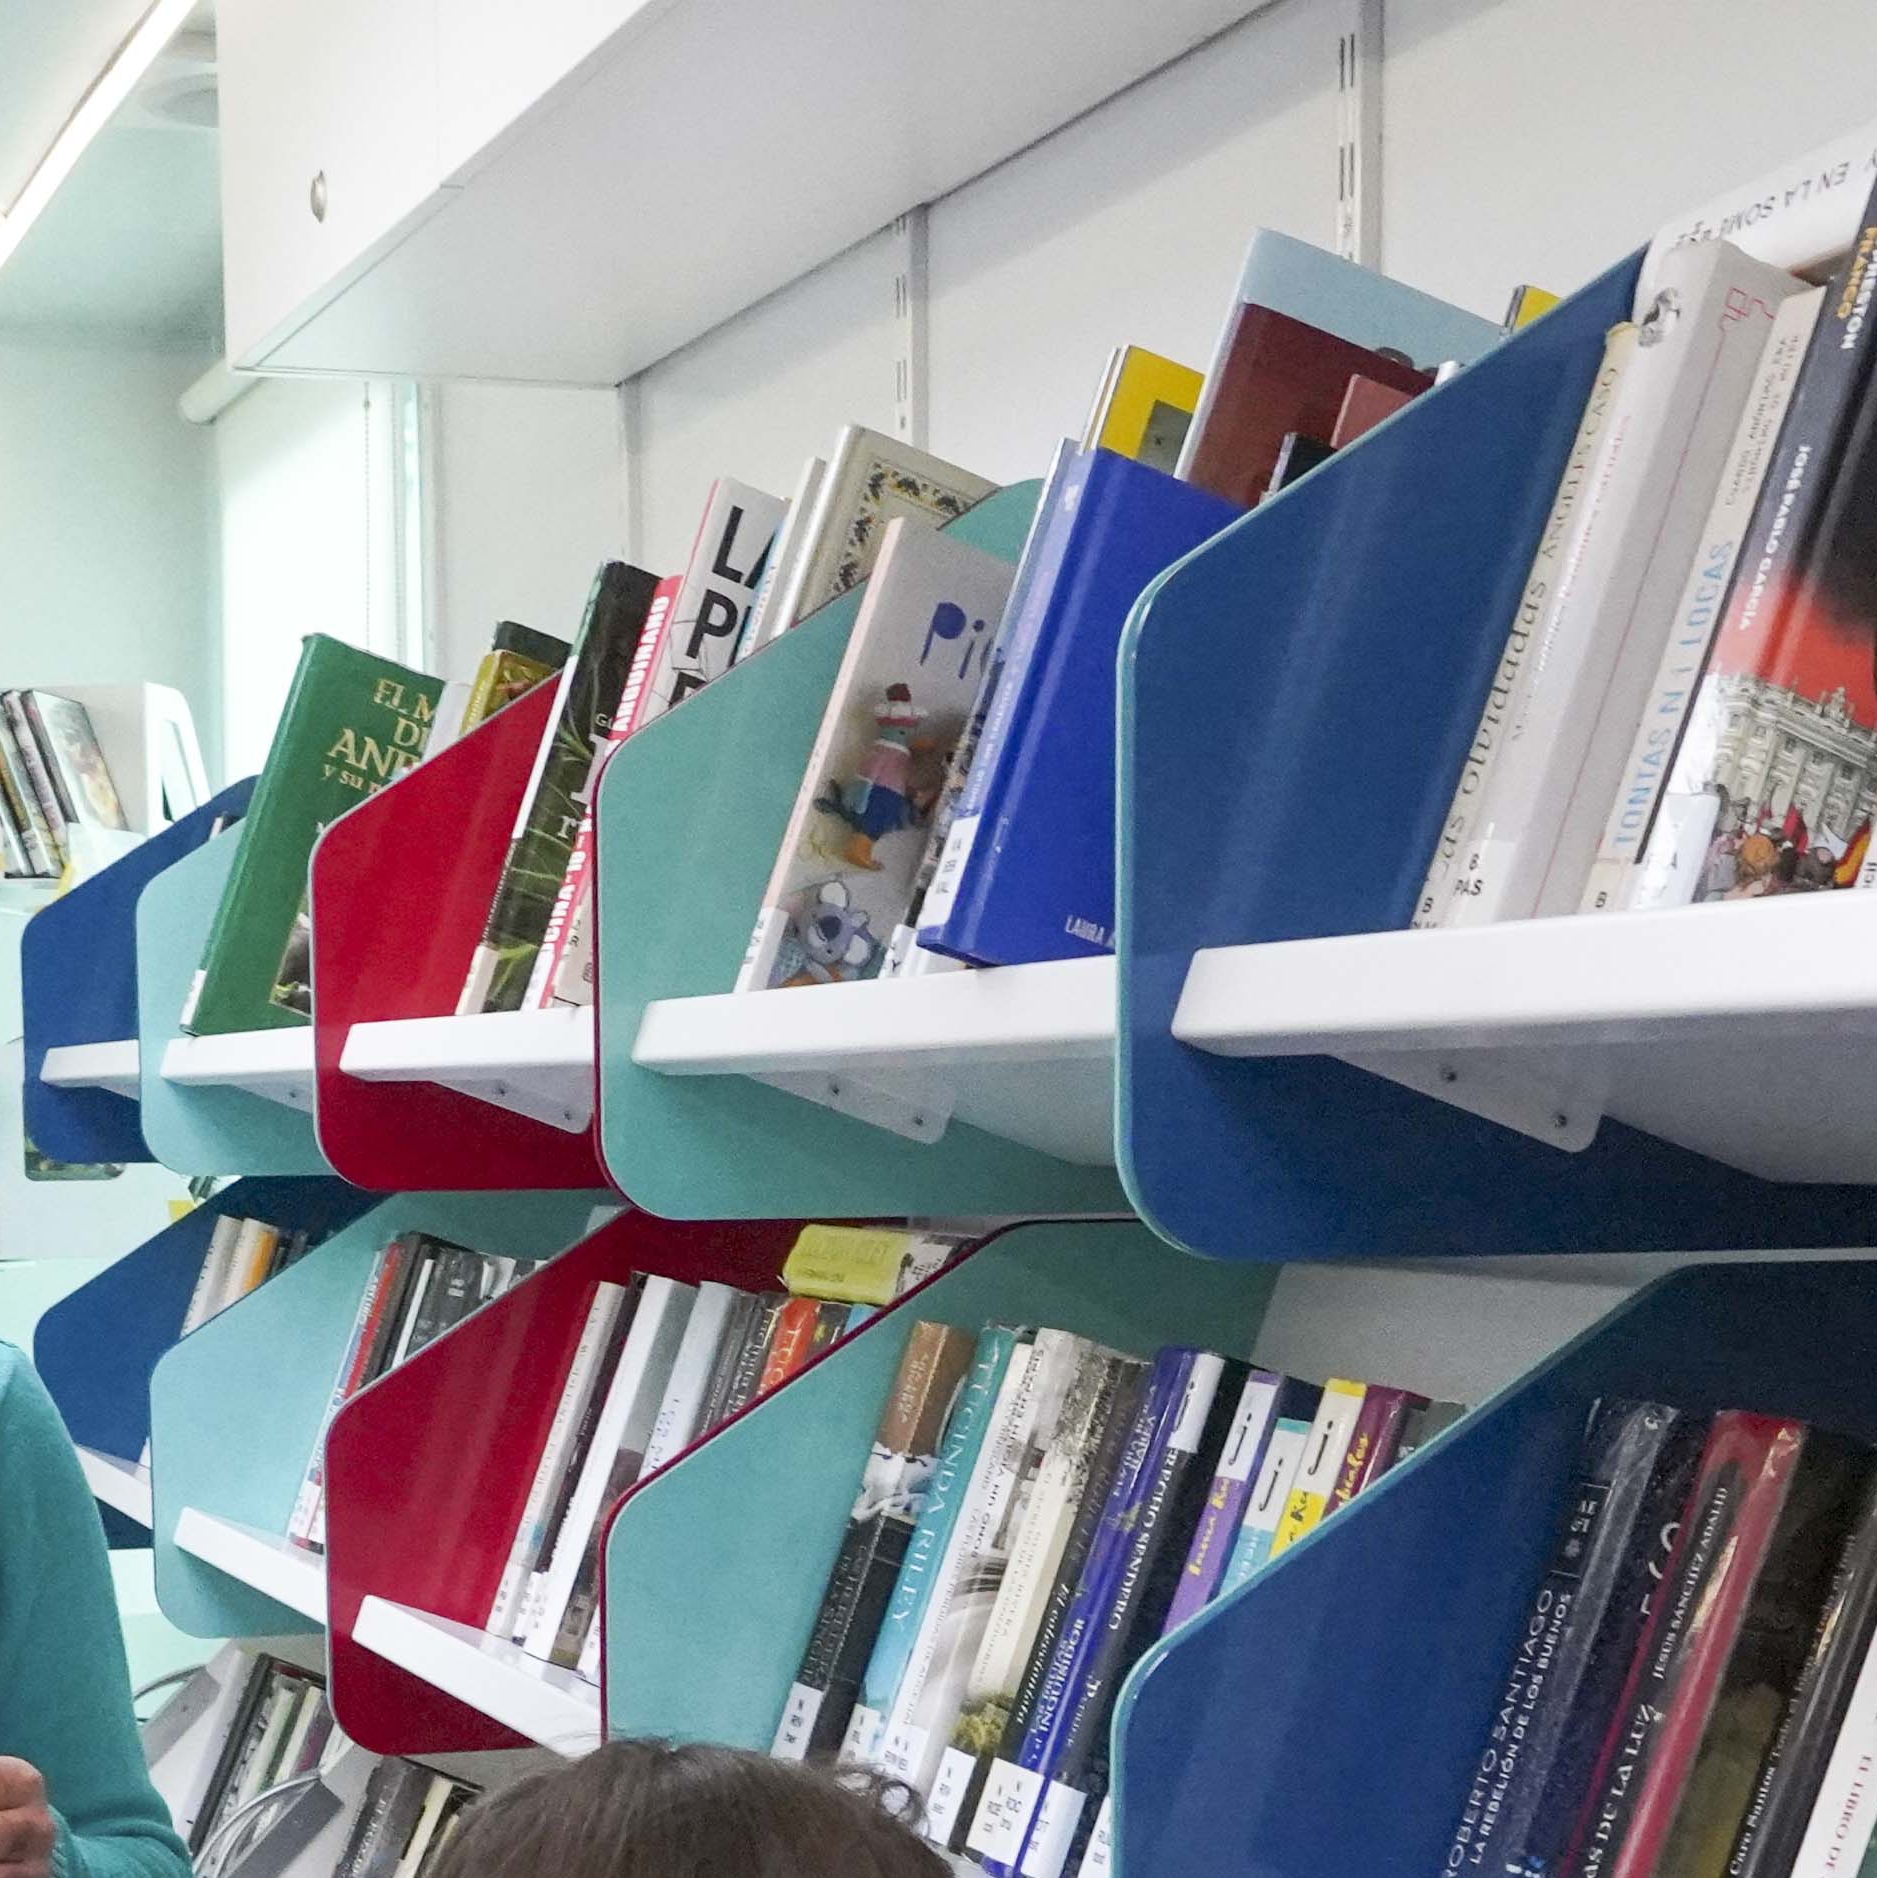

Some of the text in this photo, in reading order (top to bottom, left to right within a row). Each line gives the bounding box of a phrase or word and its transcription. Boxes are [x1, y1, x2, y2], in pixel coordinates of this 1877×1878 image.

[1783, 160, 1850, 209] EN LA
[1760, 490, 1798, 555] PABLO
[1732, 553, 1776, 633] GARCÍA
[1452, 876, 1484, 899] PAS
[1228, 1412, 1253, 1467] j
[1308, 1419, 1334, 1476] j
[1258, 1458, 1285, 1512] j
[888, 1525, 937, 1631] RILEY
[1103, 1530, 1156, 1632] SENDERO
[1652, 1485, 1730, 1680] JESÚS SÁNCHEZ ADALID
[1038, 1617, 1087, 1732] INQUISIDOR
[1491, 1585, 1554, 1743] SANTIAGO
[1469, 1589, 1570, 1865] LA REBELIÓN DE LOS BUENOS
[1854, 1752, 1873, 1774] EL
[1594, 1801, 1621, 1843] DE
[1609, 1760, 1635, 1800] LA
[1628, 1702, 1663, 1749] LUZ
[1727, 1763, 1777, 1877] Care Santos
[1832, 1778, 1864, 1842] LIBRO
[1822, 1843, 1843, 1871] DE
